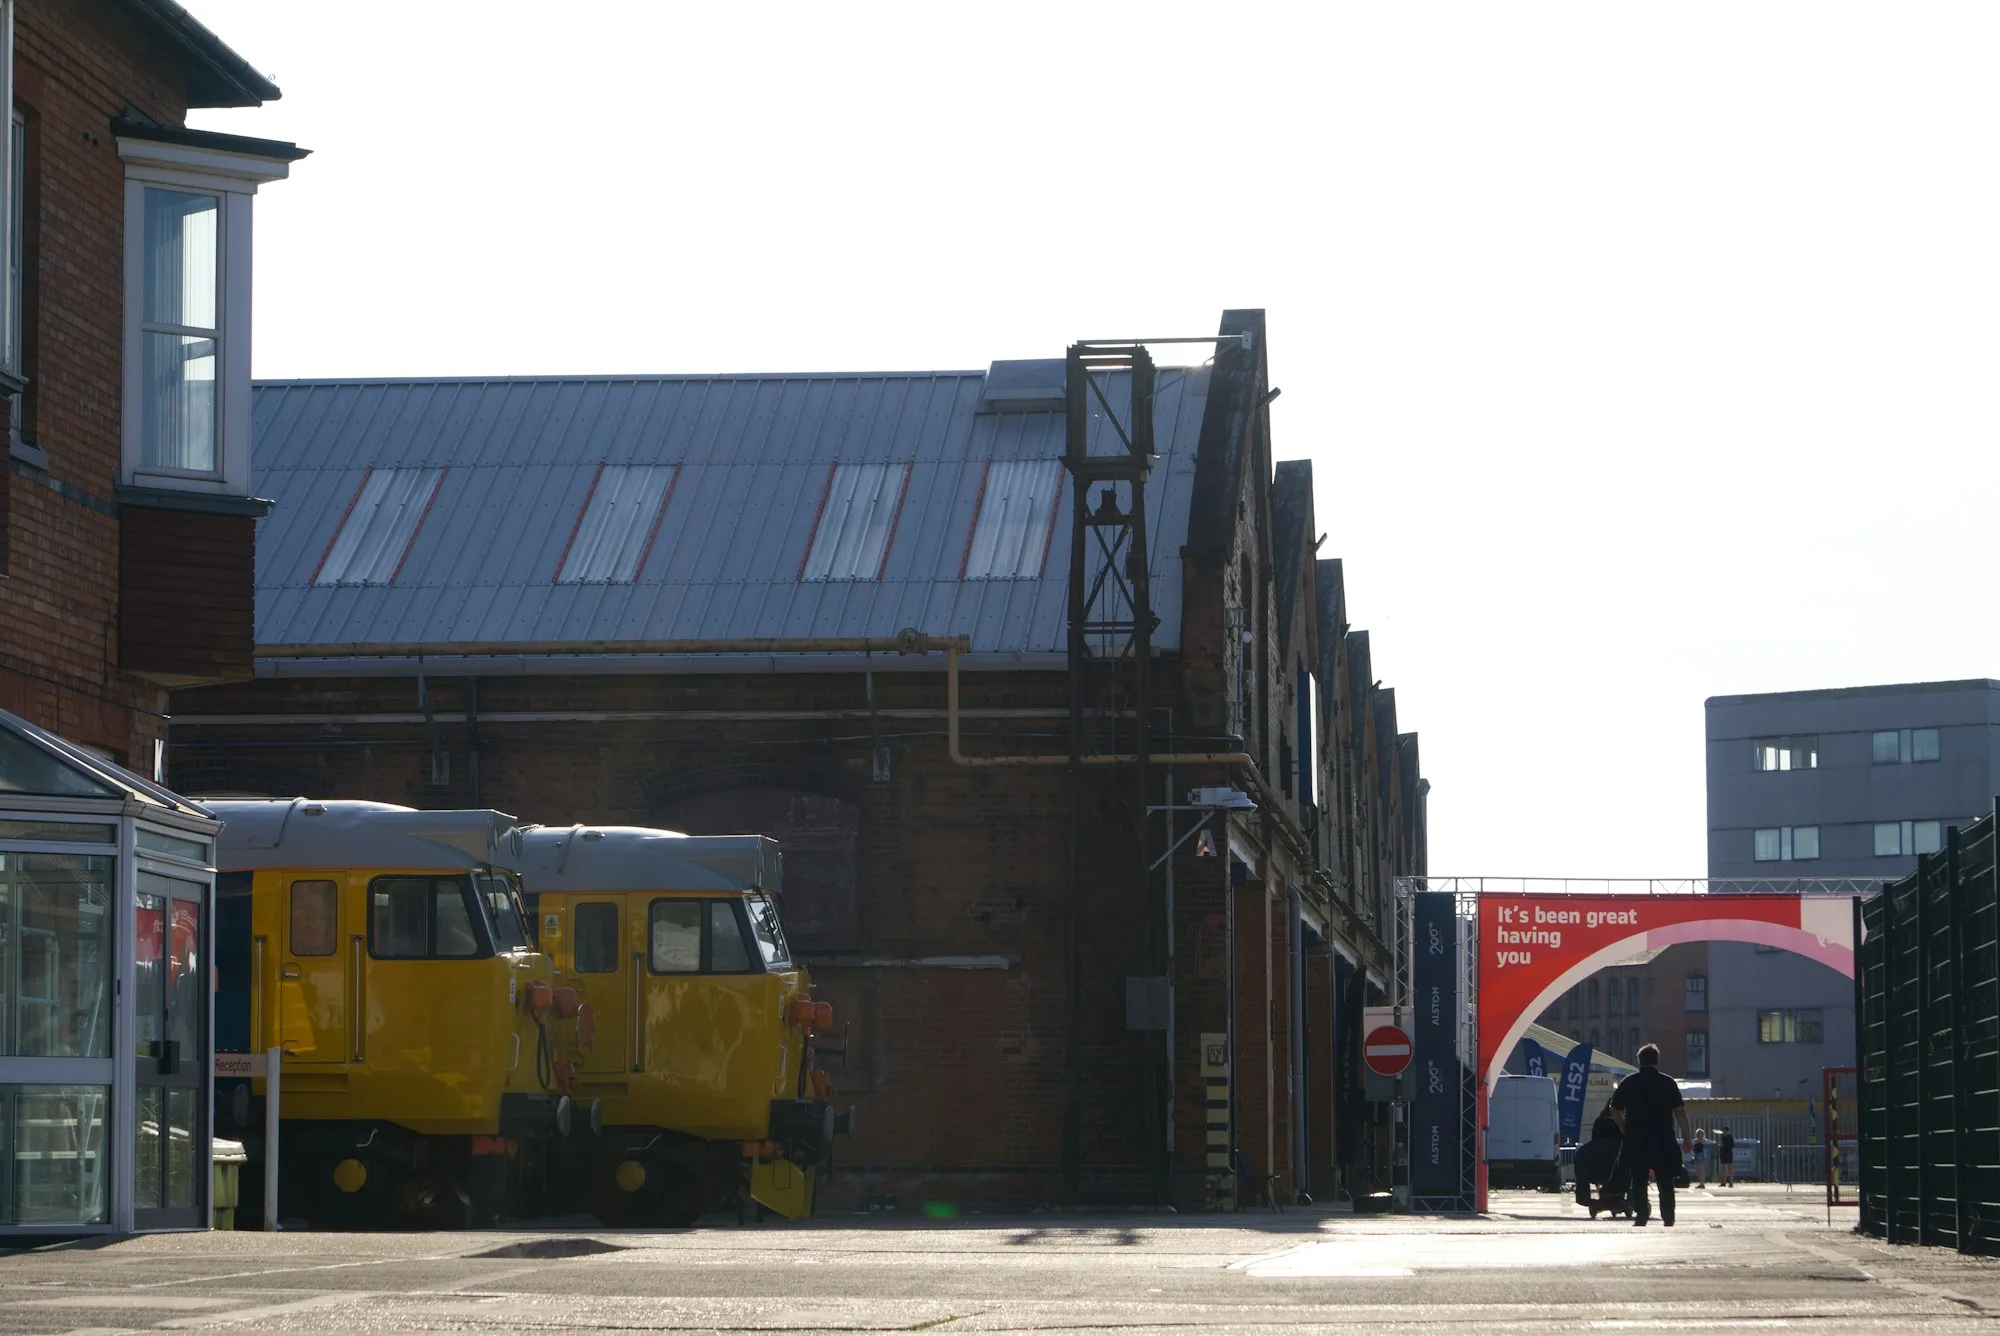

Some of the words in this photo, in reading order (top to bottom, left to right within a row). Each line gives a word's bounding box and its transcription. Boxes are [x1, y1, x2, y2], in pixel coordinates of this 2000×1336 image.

[1498, 905, 1529, 924] It's
[1535, 905, 1580, 924] been
[1587, 908, 1638, 928] great
[1497, 925, 1561, 948] having
[1497, 950, 1531, 968] you
[1431, 986, 1440, 1025] ALSTOM
[215, 1057, 252, 1075] Reception
[1529, 1056, 1543, 1077] S2
[1564, 1062, 1585, 1102] HS2
[1588, 1077, 1609, 1086] rinks
[1431, 1125, 1440, 1165] ALSTOM
